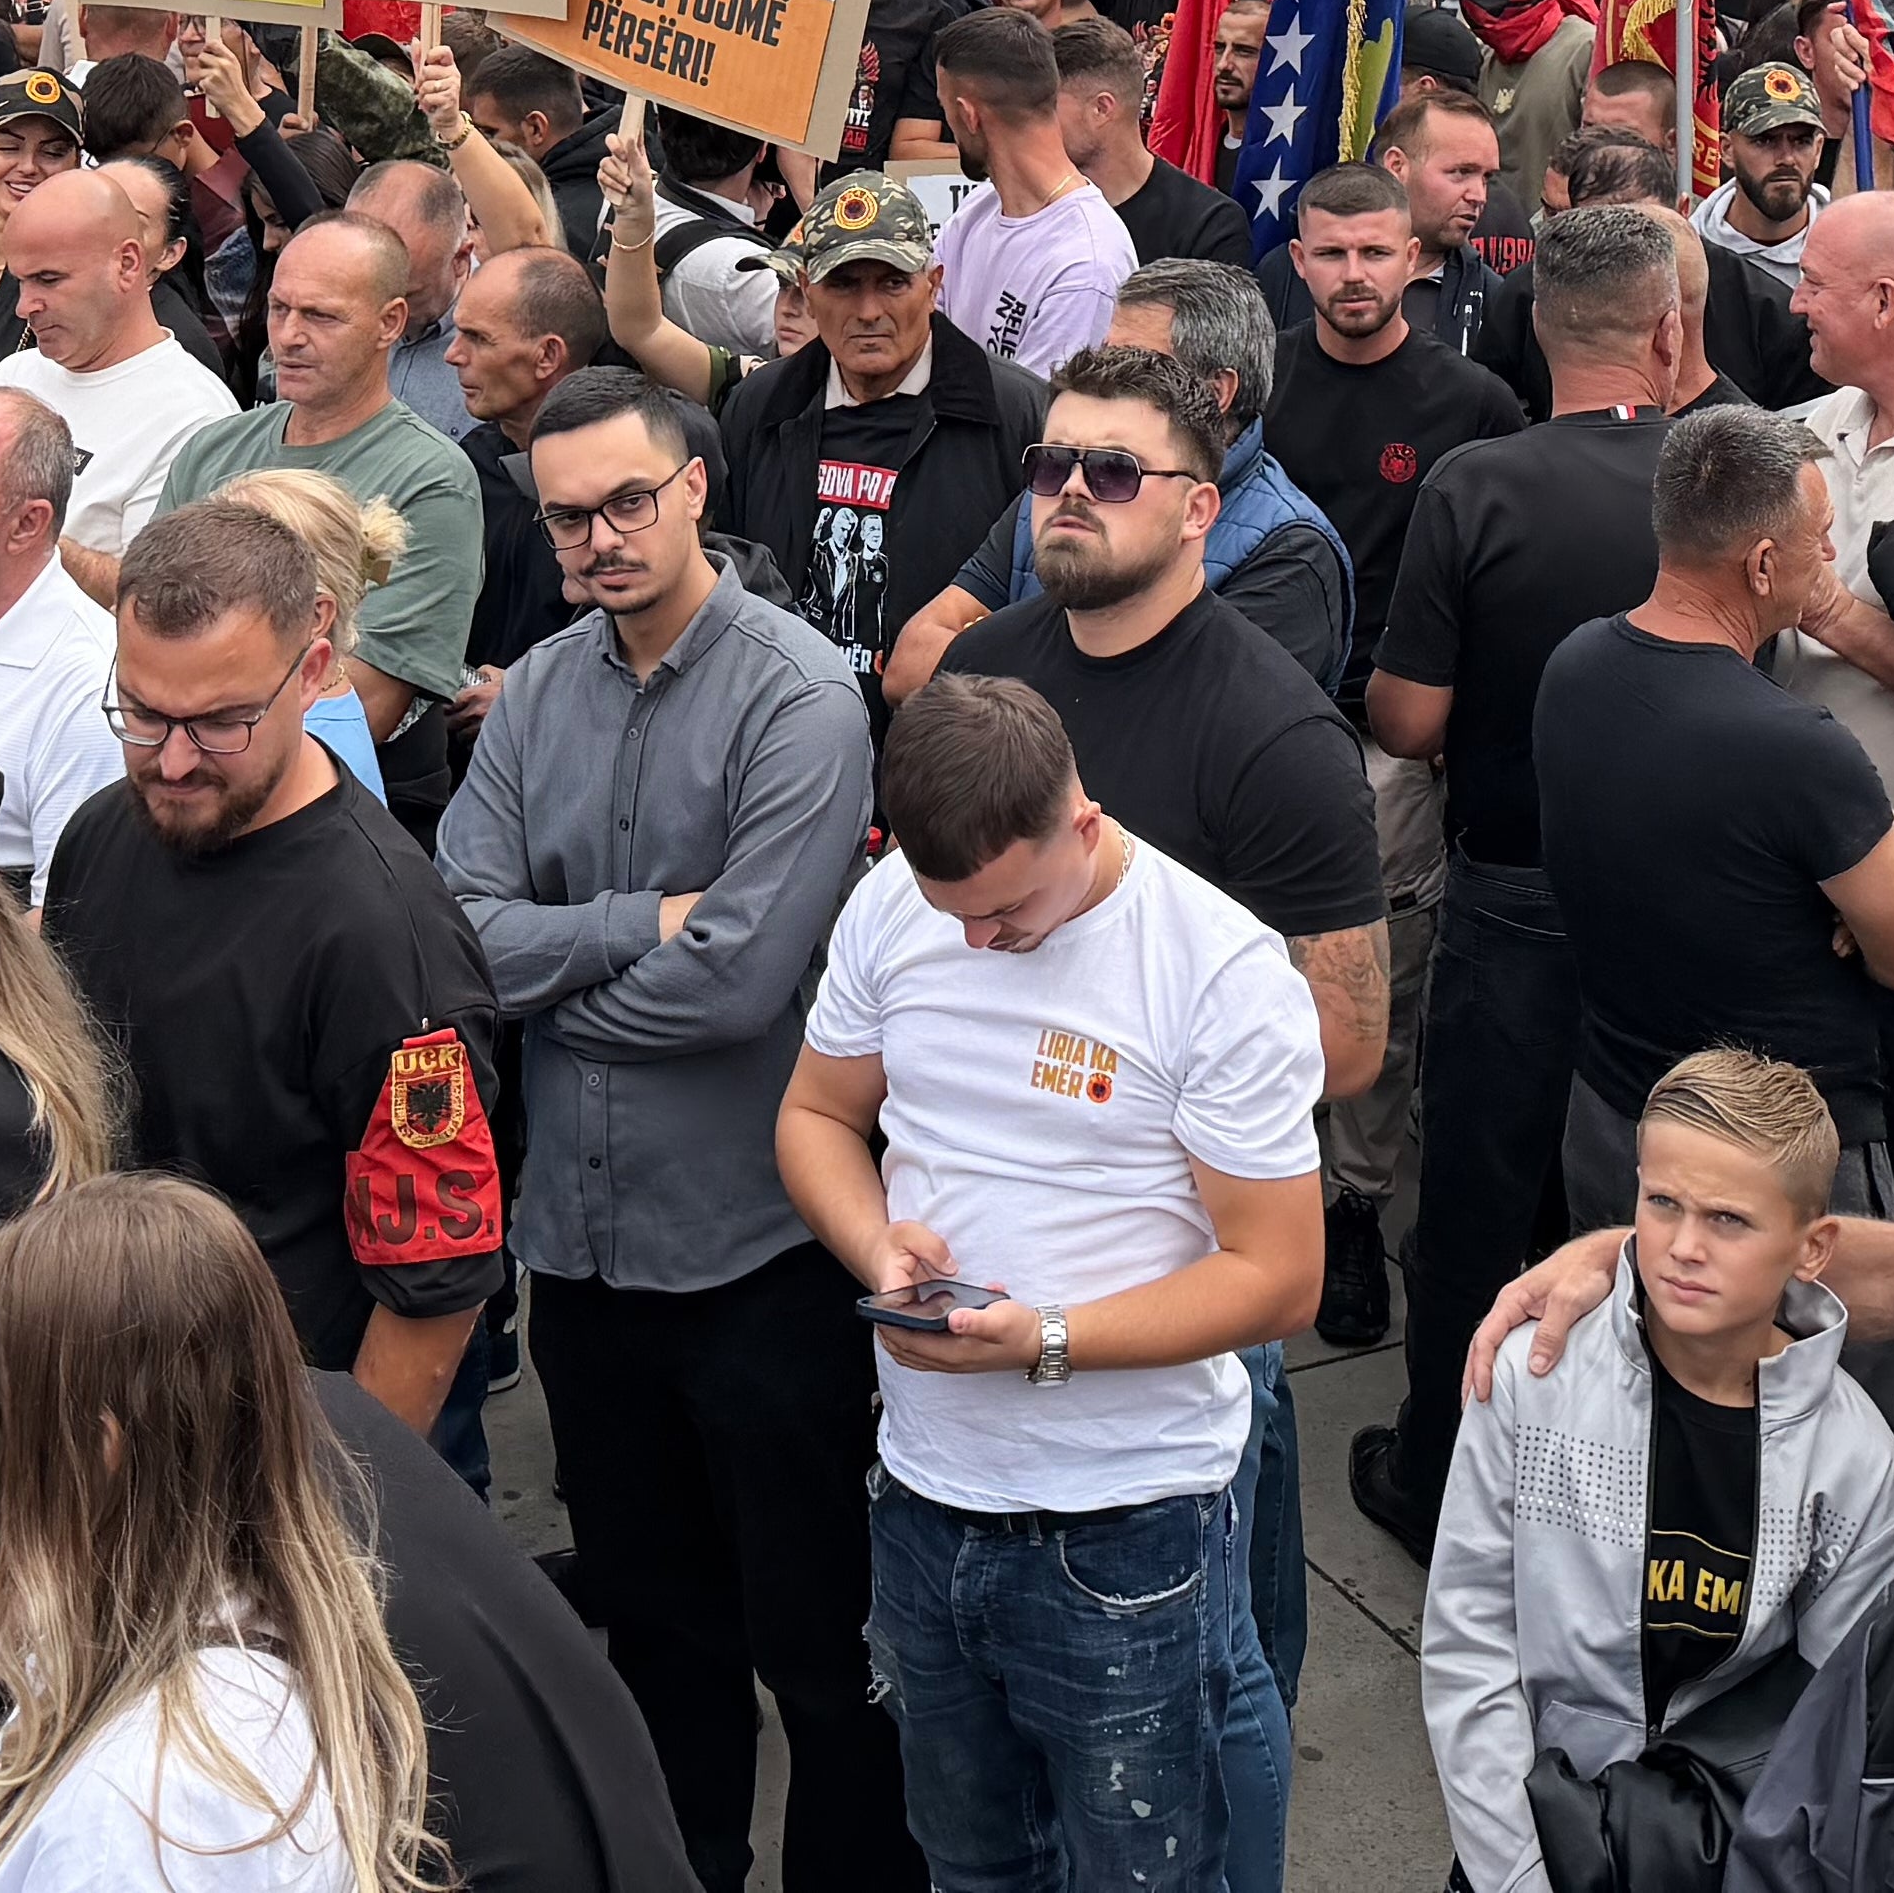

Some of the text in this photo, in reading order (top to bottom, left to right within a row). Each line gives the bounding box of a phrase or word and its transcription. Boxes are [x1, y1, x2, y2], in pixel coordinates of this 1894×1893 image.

[396, 1047, 458, 1077] UÇK
[1036, 1028, 1085, 1067] LIRIA
[1030, 1058, 1084, 1100] EMËR
[1647, 1559, 1744, 1616] KA EM
